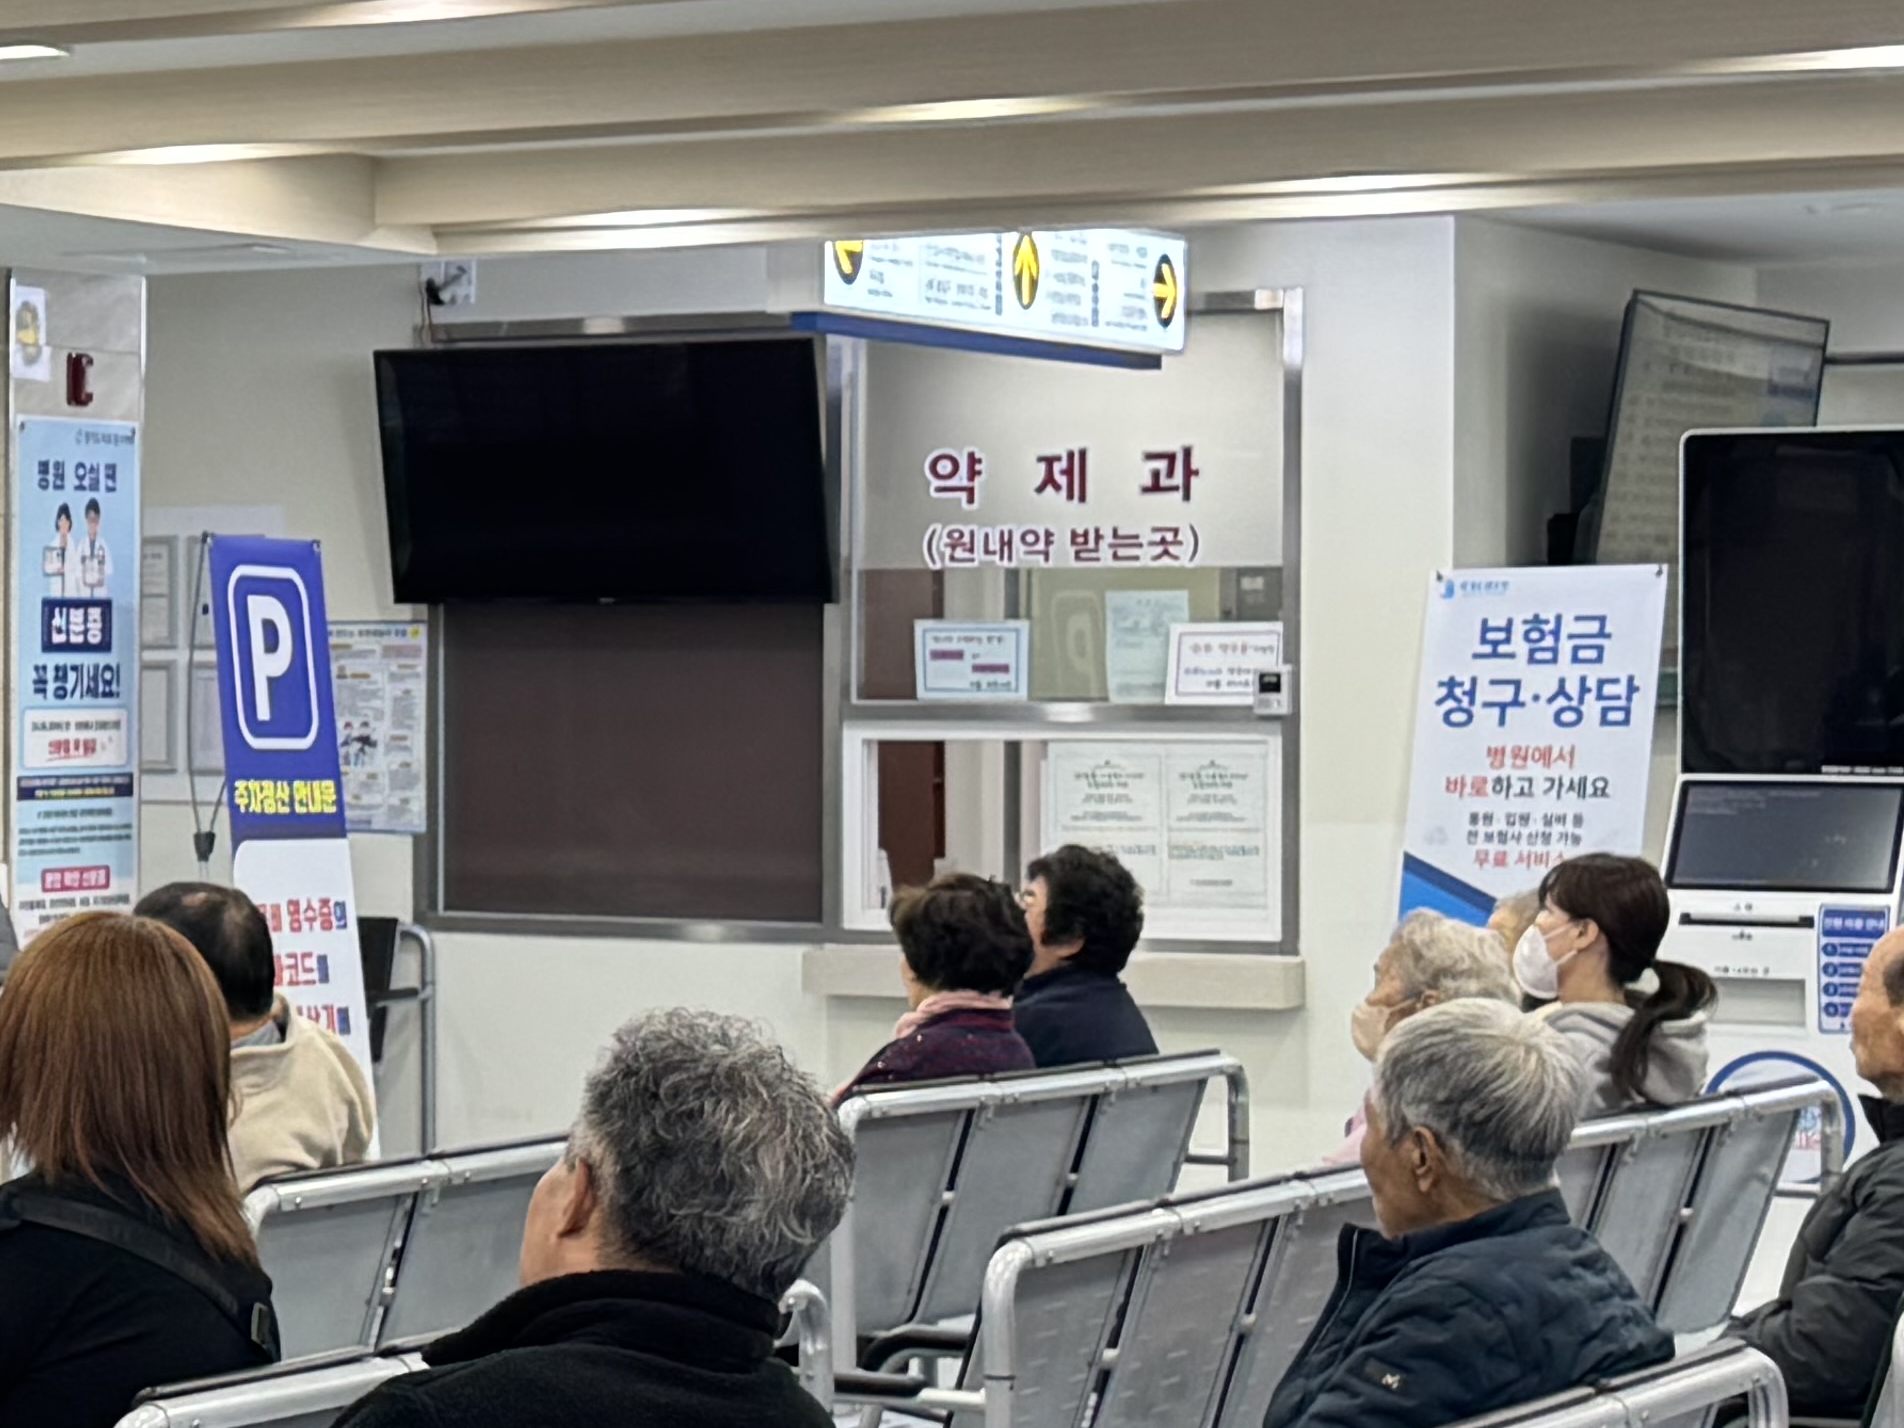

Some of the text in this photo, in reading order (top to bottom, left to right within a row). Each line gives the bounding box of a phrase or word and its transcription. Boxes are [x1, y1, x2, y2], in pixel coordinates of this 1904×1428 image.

[37, 459, 65, 491] 병원
[74, 461, 100, 492] 오실
[924, 524, 1200, 566] (원내약 받는곳)
[51, 606, 103, 645] 신분증
[1471, 613, 1612, 665] 보험금
[246, 592, 294, 723] P
[53, 661, 120, 700] 챙기세요!
[1434, 674, 1640, 728] 청구·상담
[1486, 744, 1576, 770] 병원에서
[234, 779, 337, 814] 주차정산 안내문
[1445, 775, 1610, 800] 바로하고 가세요
[287, 898, 348, 934] 영수증의
